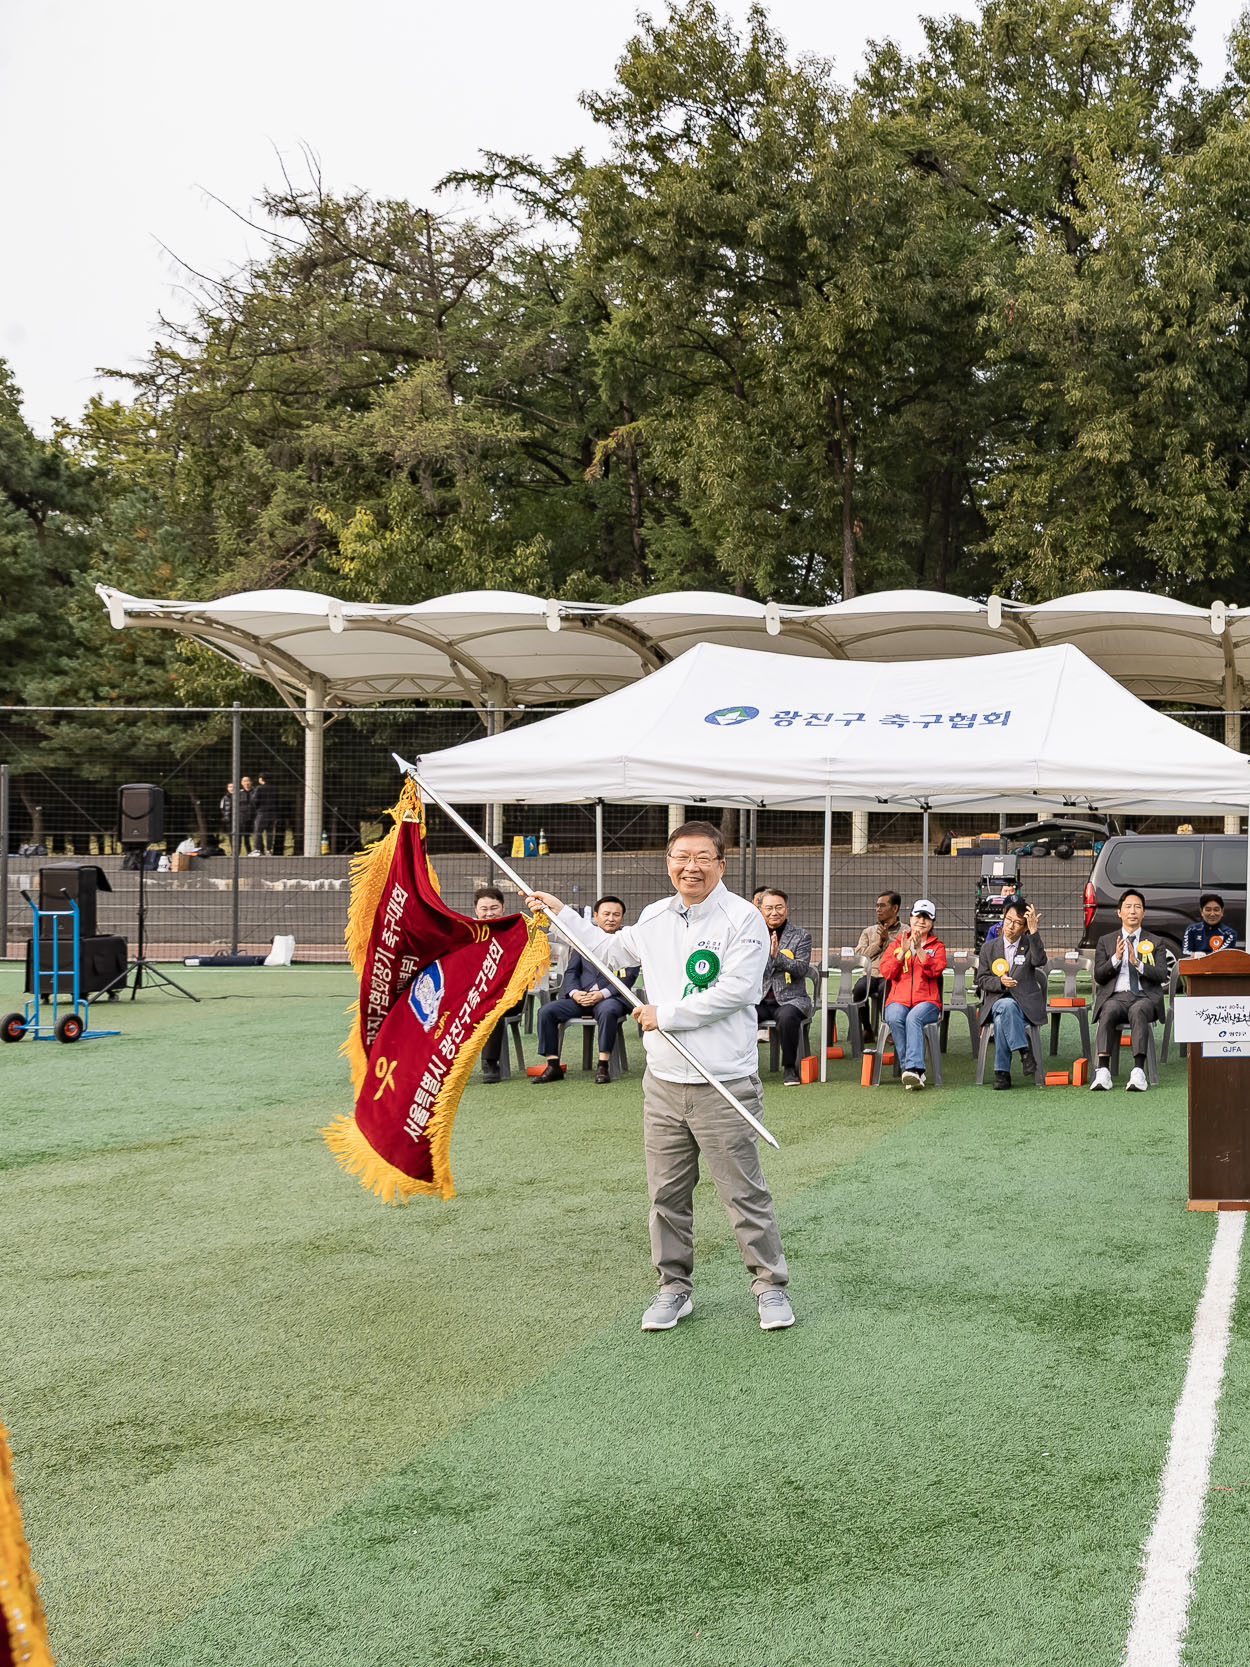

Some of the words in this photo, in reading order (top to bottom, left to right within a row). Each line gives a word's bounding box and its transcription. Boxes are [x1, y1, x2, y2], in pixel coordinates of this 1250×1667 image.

[769, 710, 866, 727] 광진구
[879, 710, 1012, 729] 축구협회
[381, 882, 409, 949] 축구대회
[402, 1054, 448, 1143] 서울특별시
[438, 937, 505, 1061] 광진구축구협회
